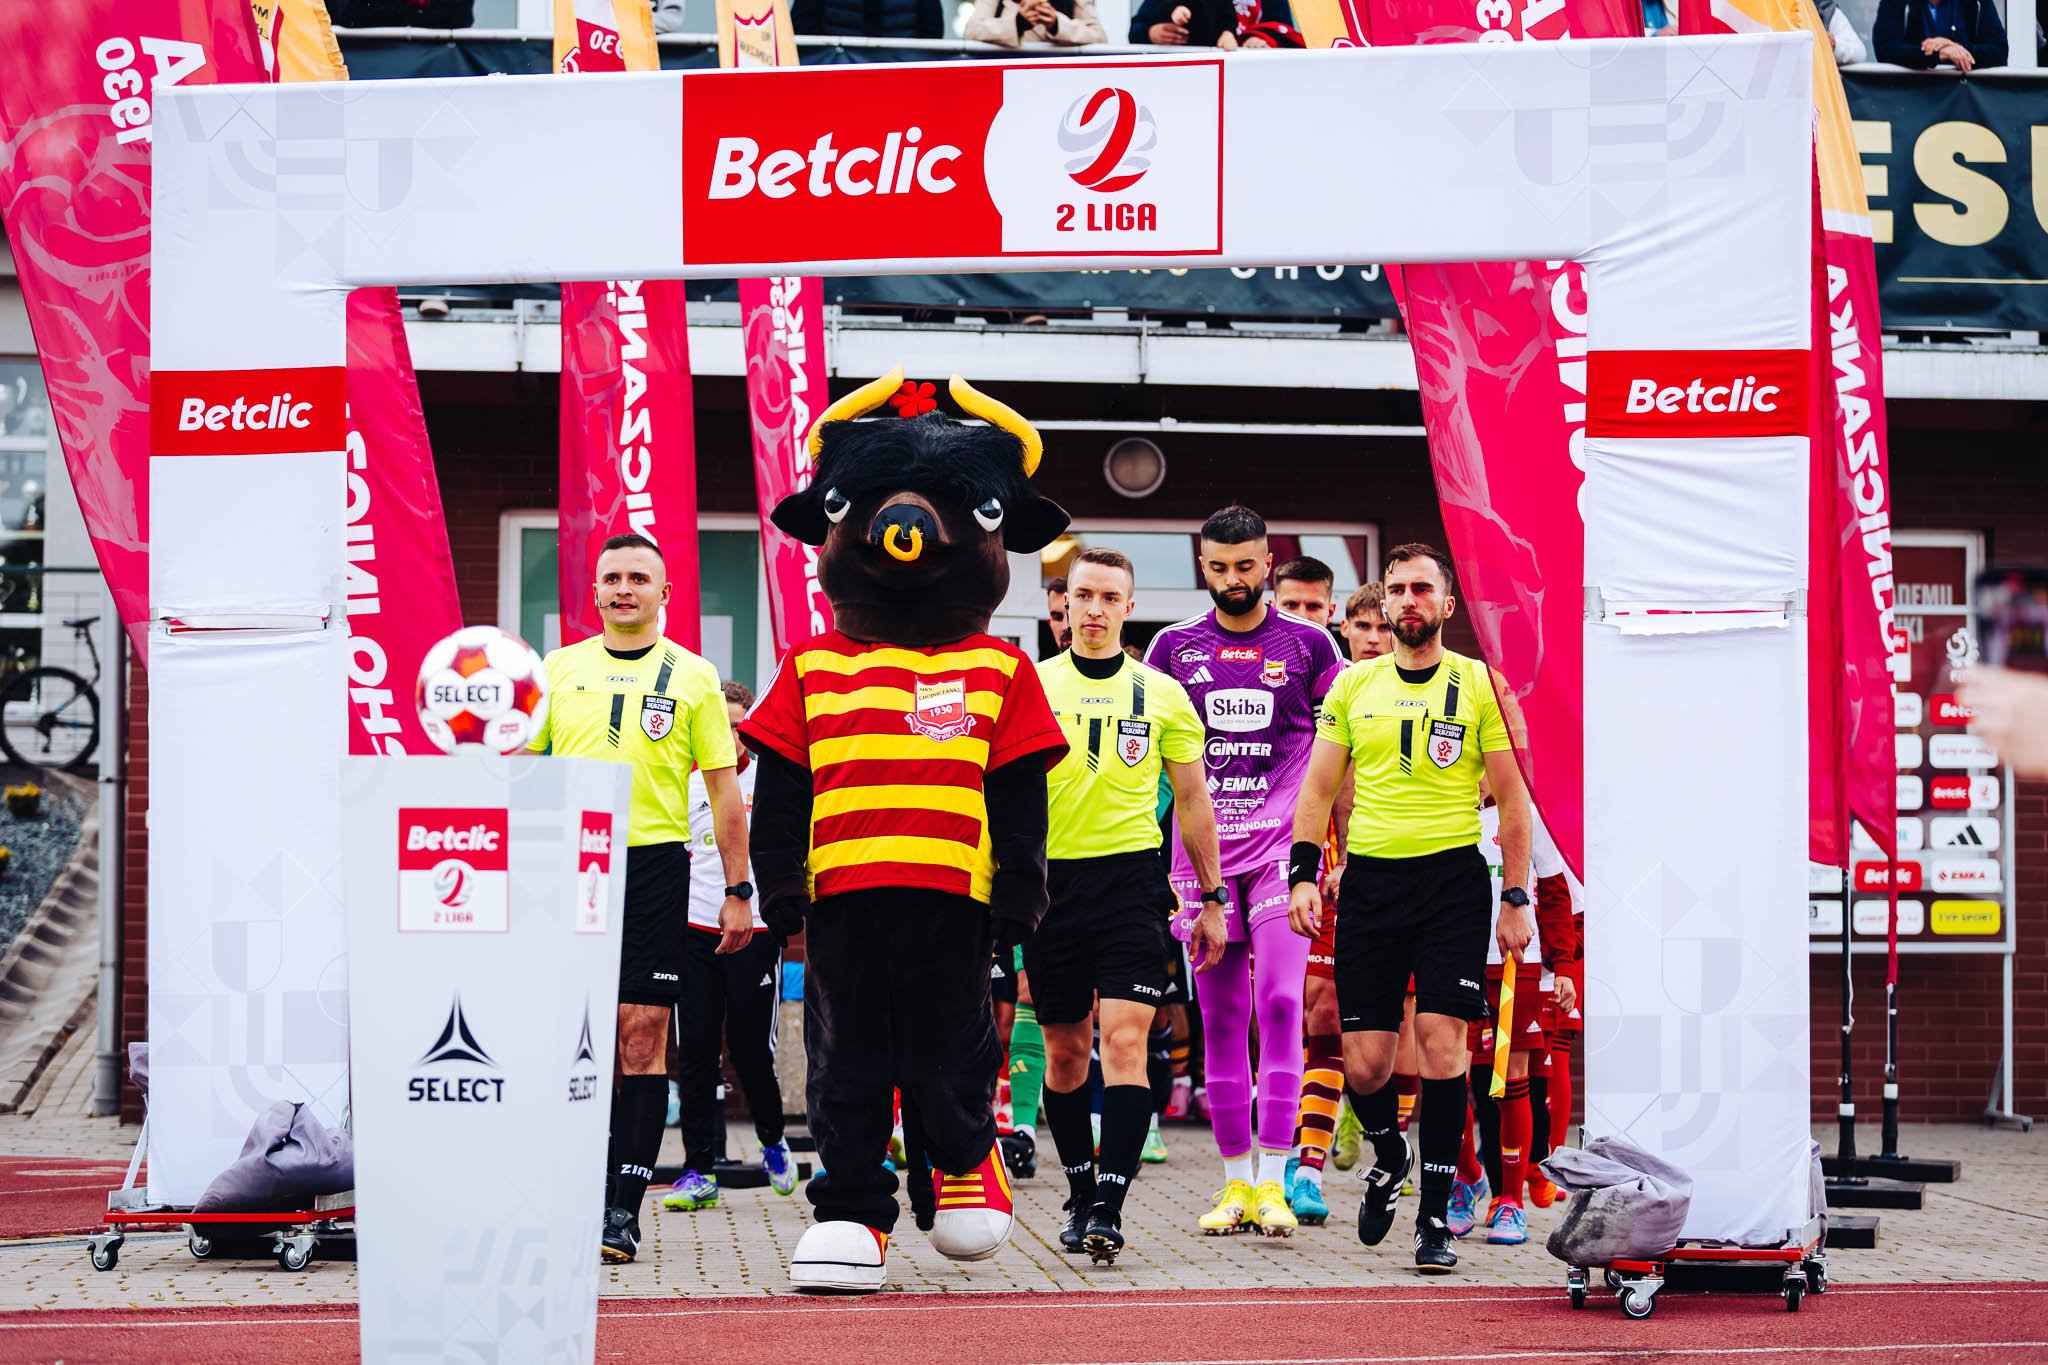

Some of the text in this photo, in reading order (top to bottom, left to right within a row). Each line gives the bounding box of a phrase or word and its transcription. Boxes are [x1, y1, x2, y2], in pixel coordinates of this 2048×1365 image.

[708, 127, 962, 199] Betclic
[1056, 203, 1157, 231] 2 LIGA
[1625, 375, 1781, 414] Betclic
[178, 392, 313, 432] Betclic
[1220, 649, 1258, 660] Betclic
[434, 685, 501, 703] SELECT
[930, 705, 953, 717] 1930
[1213, 698, 1266, 716] Skiba
[1208, 742, 1272, 757] GINTER
[1221, 776, 1268, 792] EMKA
[406, 824, 500, 851] Betclic
[408, 1077, 504, 1103] SELECT
